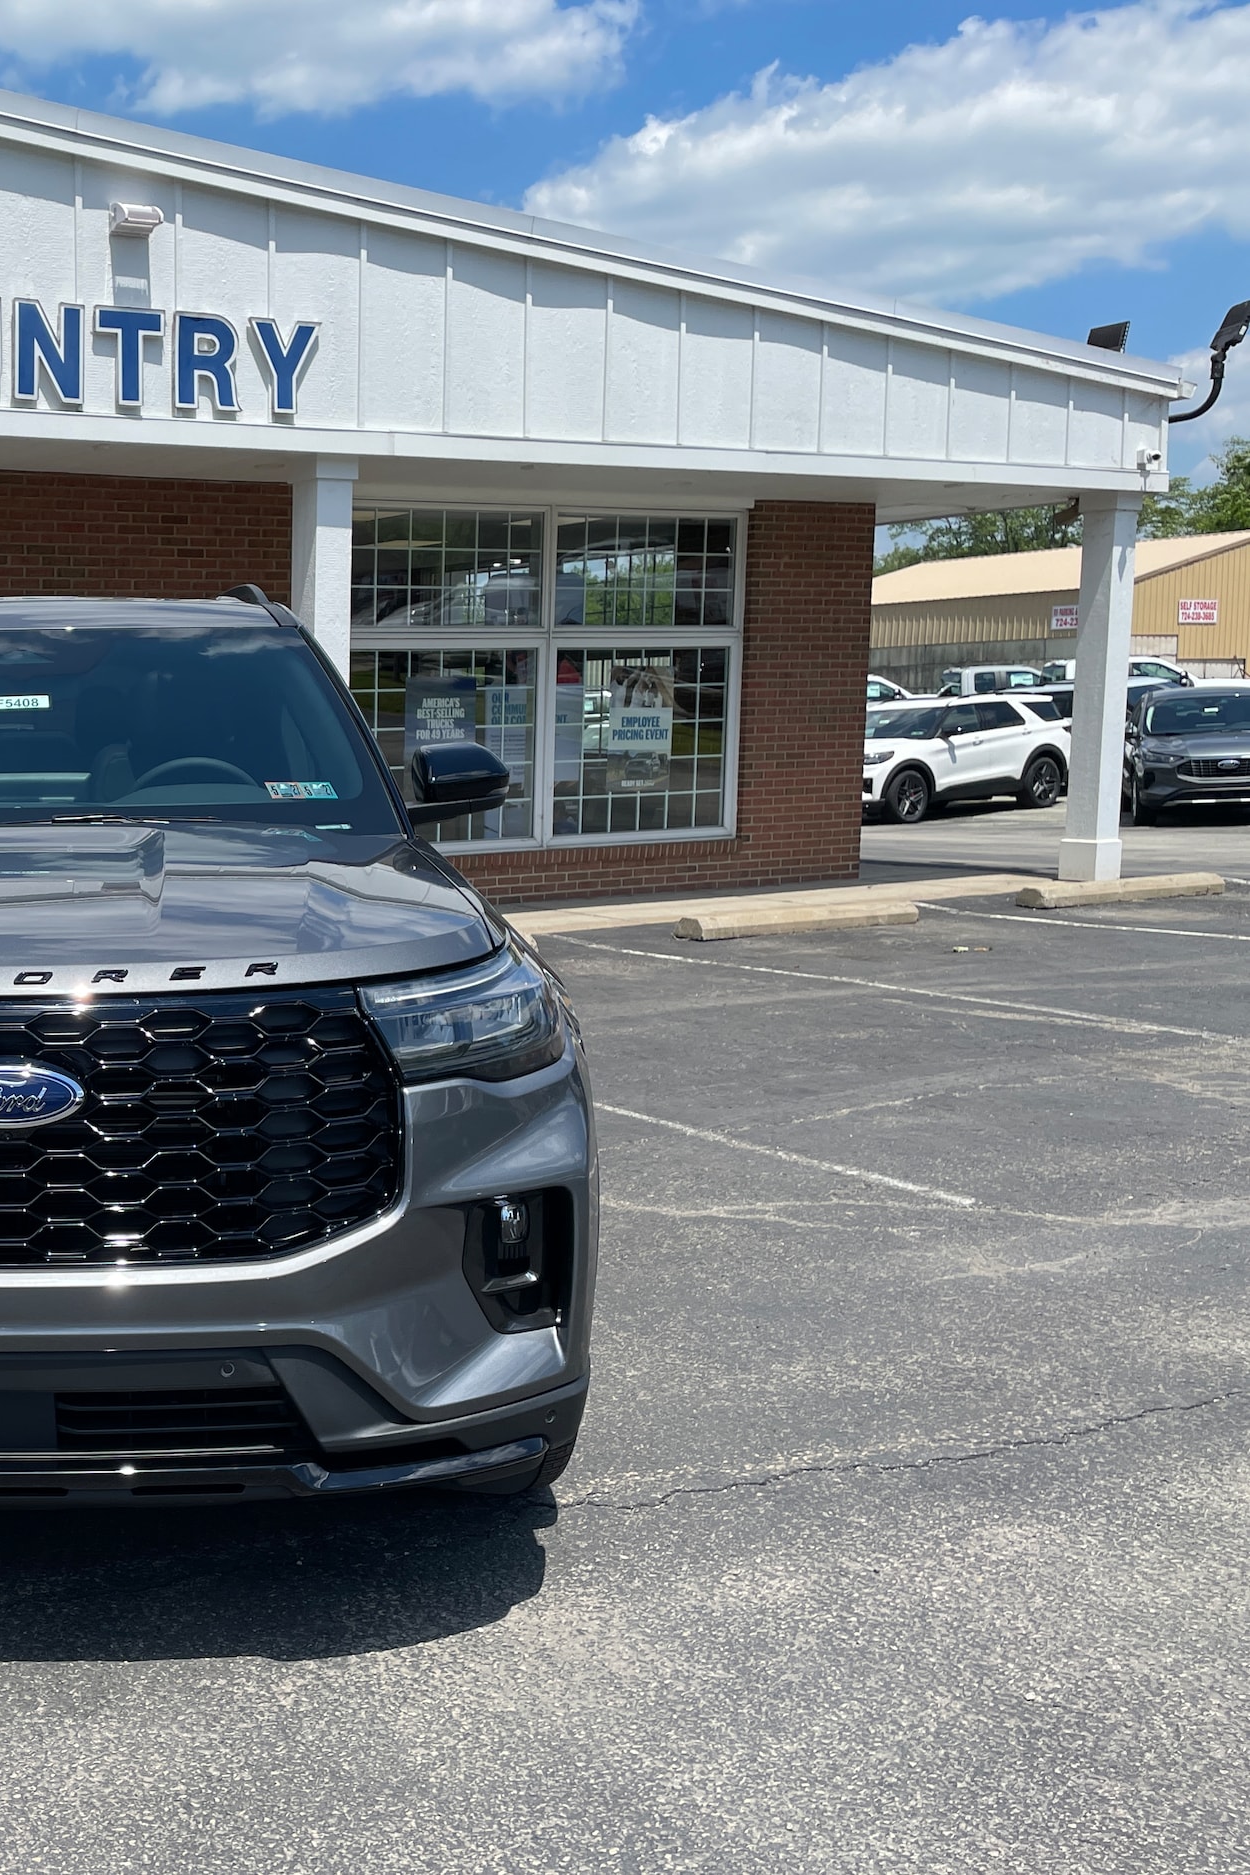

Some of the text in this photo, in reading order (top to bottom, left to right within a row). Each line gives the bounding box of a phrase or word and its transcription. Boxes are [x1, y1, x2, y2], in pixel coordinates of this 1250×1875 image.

[1180, 601, 1217, 610] SELF STORAGE
[1055, 617, 1079, 627] 724-23
[422, 697, 461, 708] AMERICA'S
[416, 708, 465, 719] BEST-SELLING
[426, 718, 455, 729] TRUCKS
[621, 716, 660, 728] EMPLOYEE
[416, 728, 465, 740] FOR 49 YEARS
[612, 728, 669, 741] PRICING EVENT
